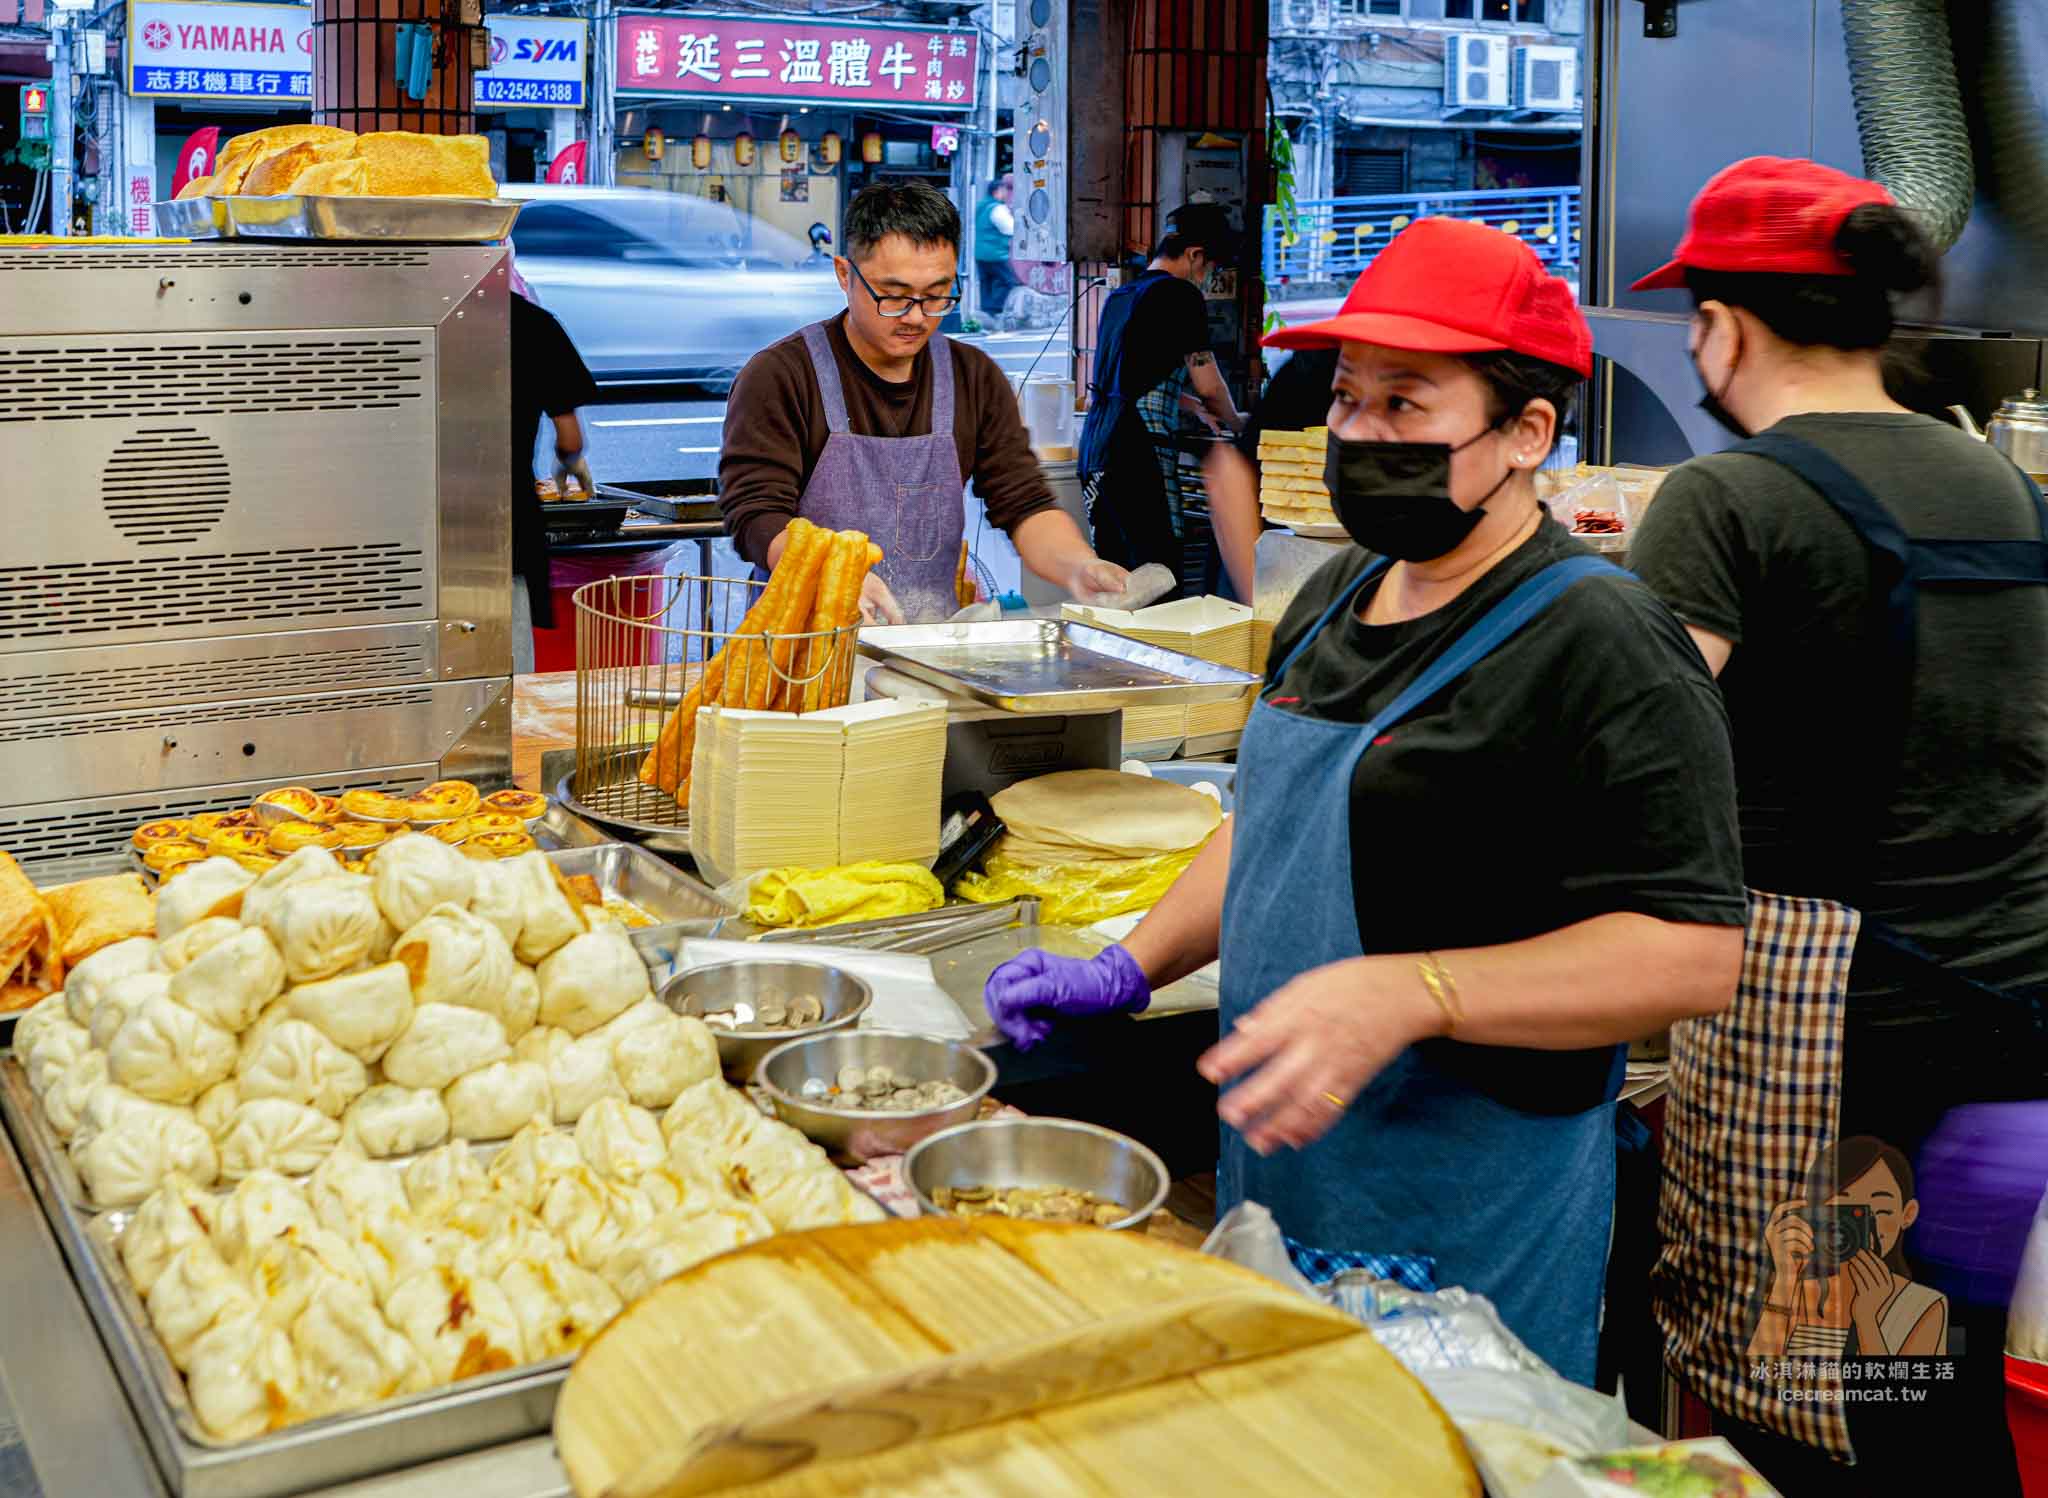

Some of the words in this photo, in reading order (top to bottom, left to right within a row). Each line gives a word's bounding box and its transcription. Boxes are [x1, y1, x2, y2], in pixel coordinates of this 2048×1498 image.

[177, 24, 285, 54] YAMAHA
[513, 38, 576, 63] SYM
[675, 33, 917, 90] 延三溫體牛
[924, 35, 945, 100] 牛肉湯
[145, 69, 281, 93] 志邦機車行
[488, 81, 572, 101] 02-2542-1388
[130, 175, 151, 234] 機車
